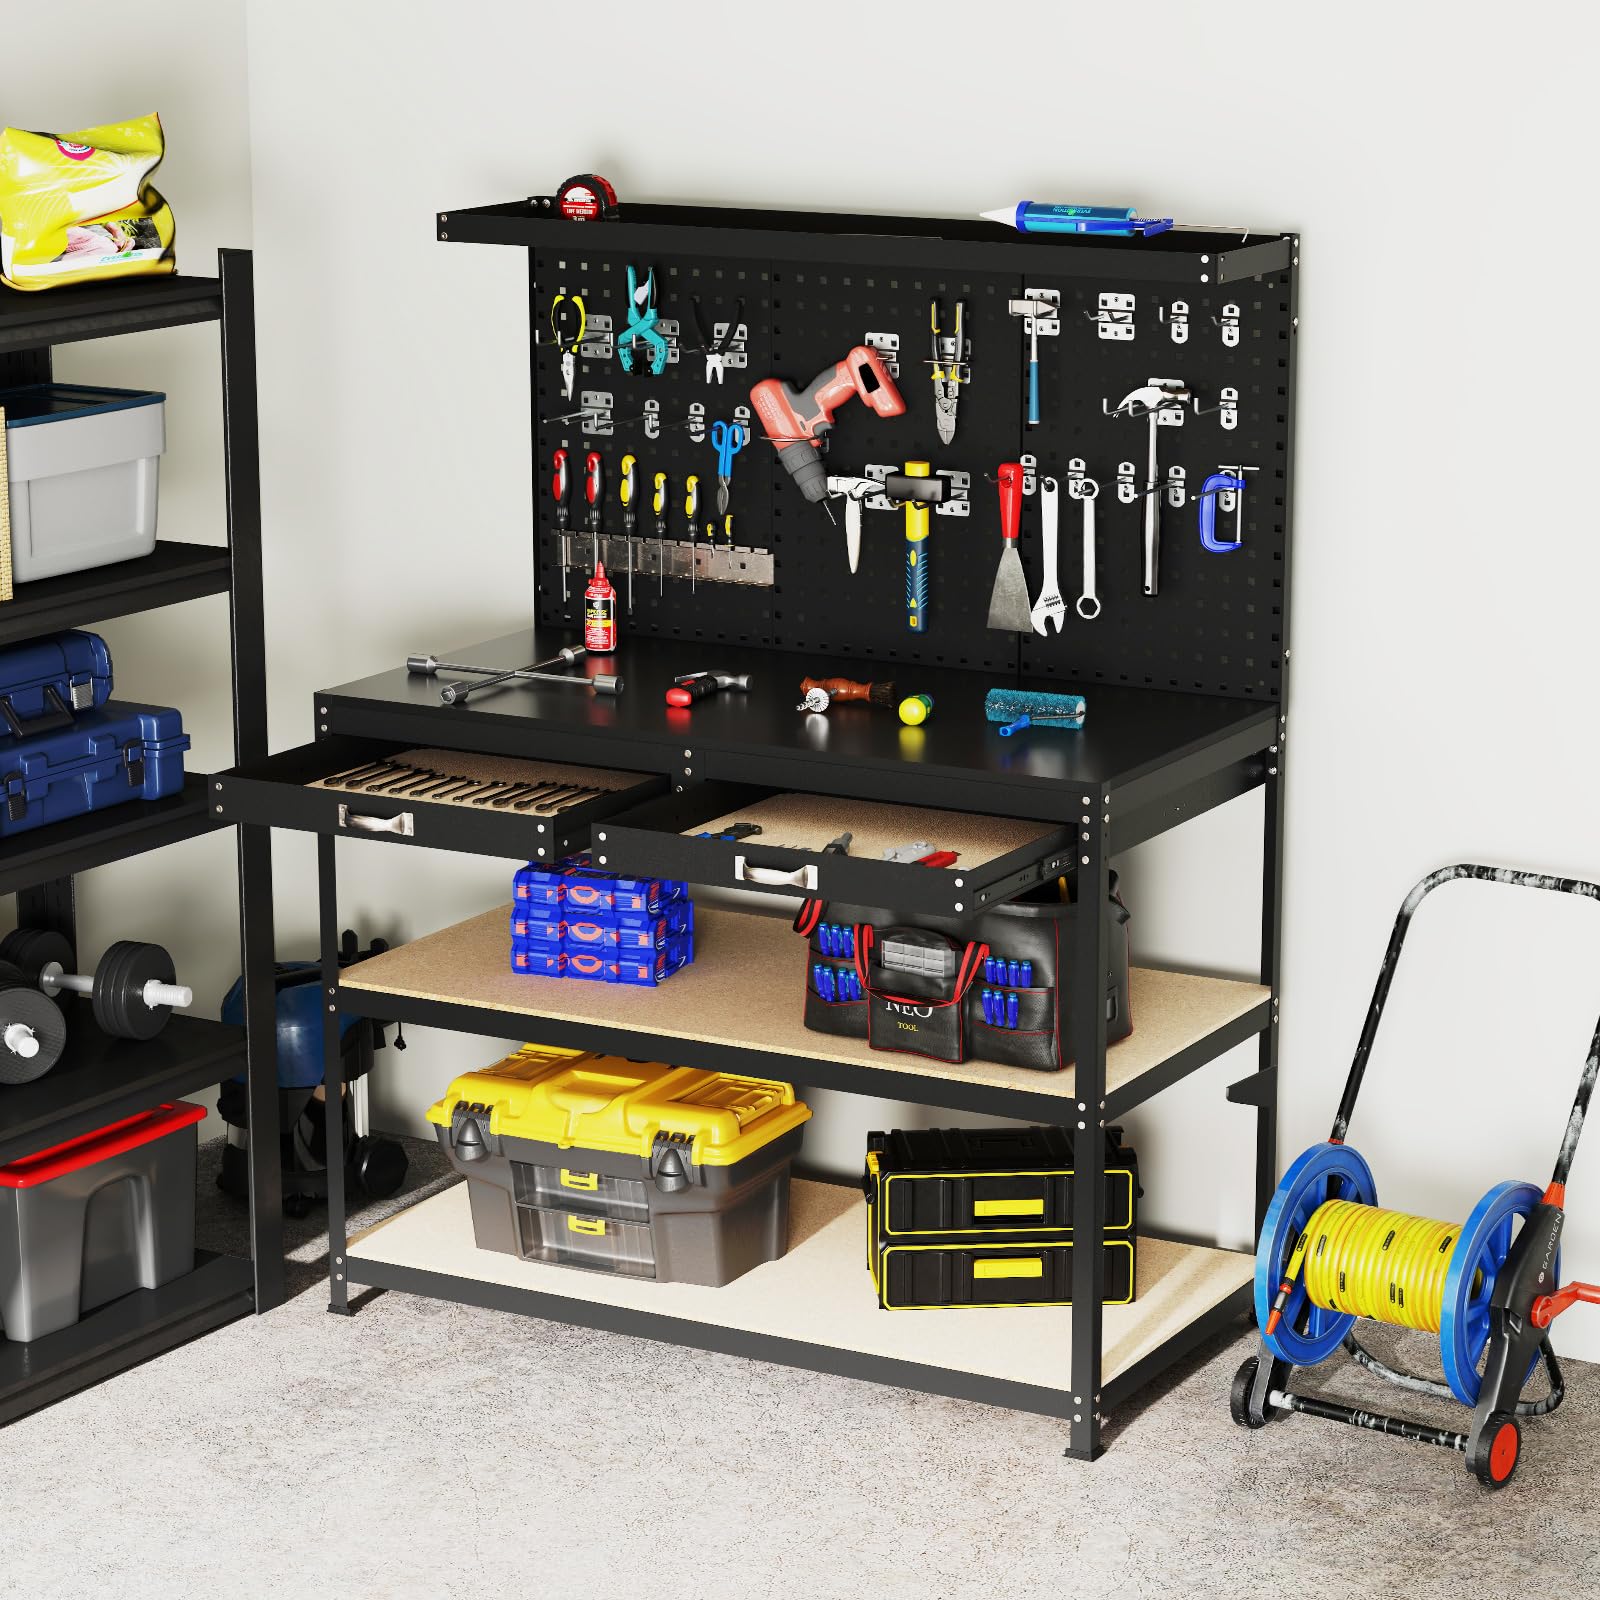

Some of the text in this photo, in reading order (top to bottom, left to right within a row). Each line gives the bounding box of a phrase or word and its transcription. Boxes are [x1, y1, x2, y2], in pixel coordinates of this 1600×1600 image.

[886, 1002, 933, 1018] NEO
[897, 1021, 919, 1032] TOOL
[1542, 1213, 1562, 1270] GARDEN
